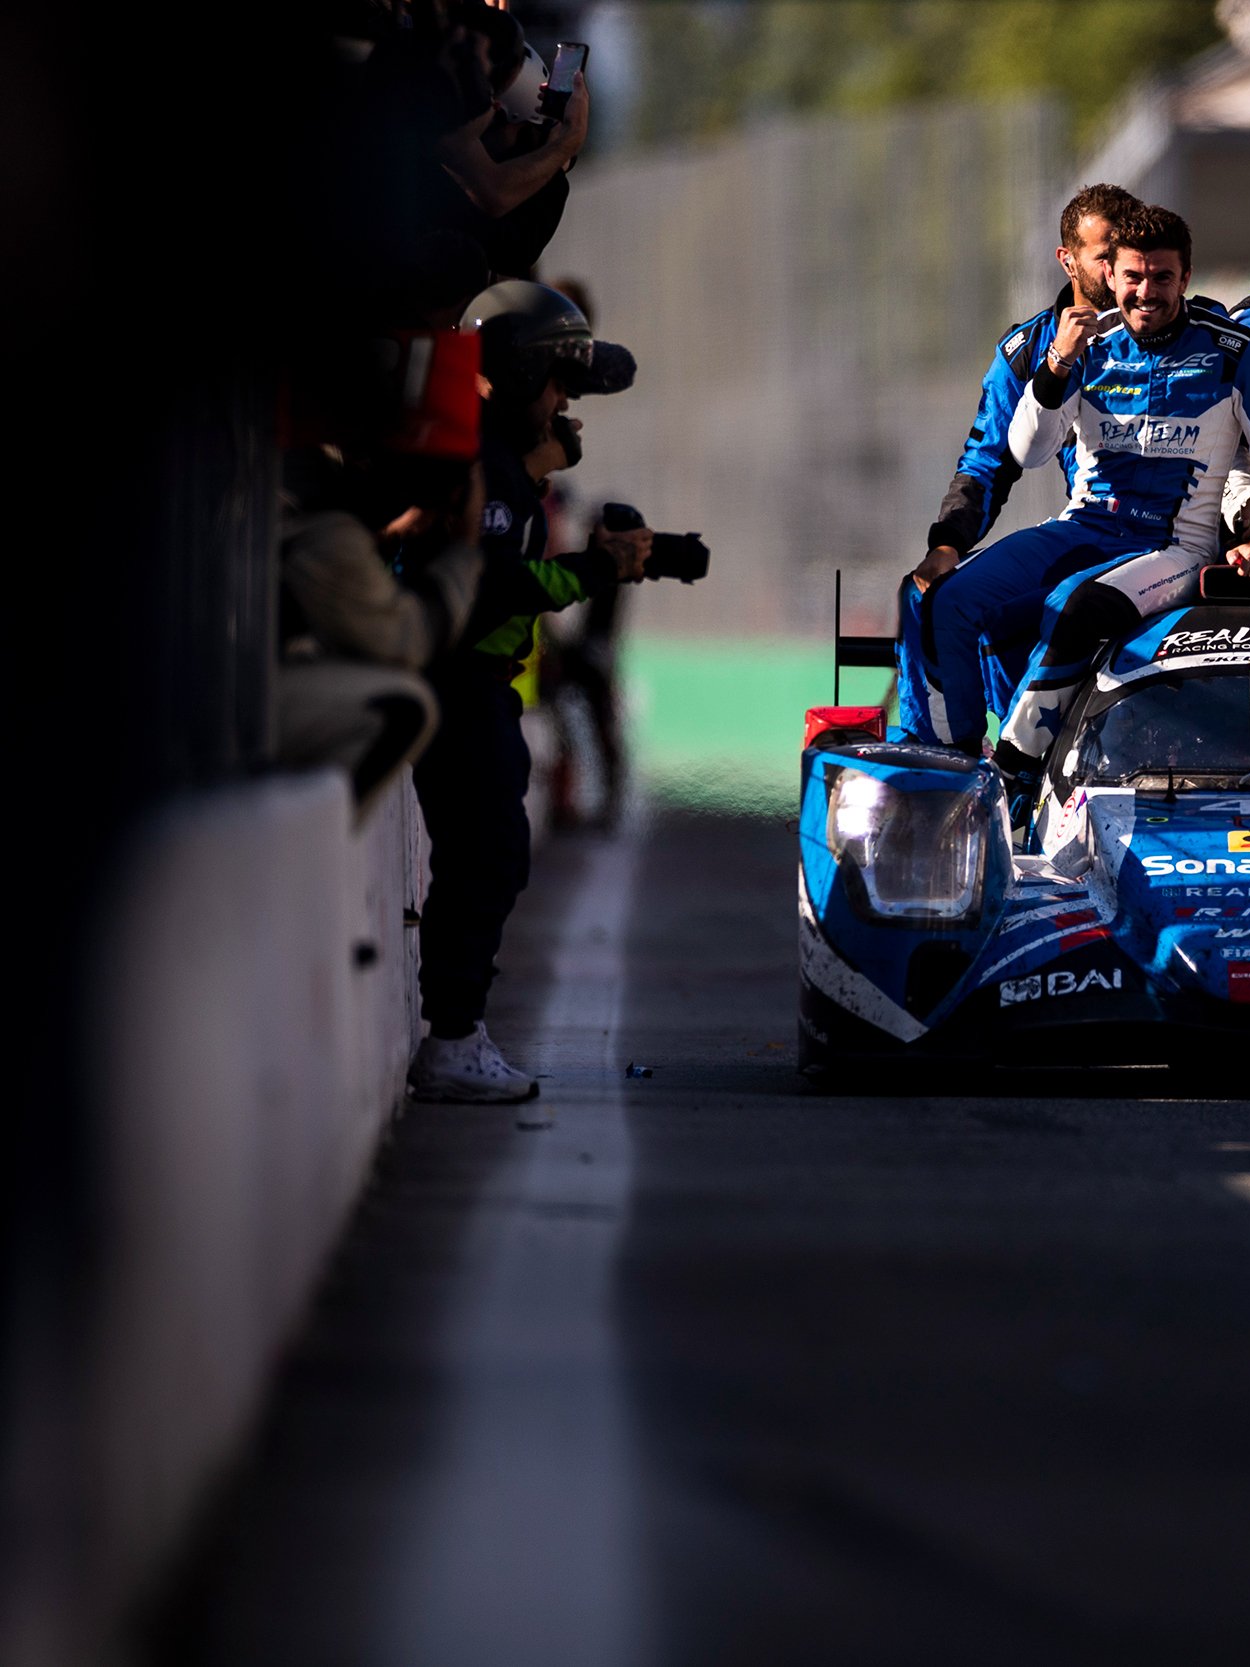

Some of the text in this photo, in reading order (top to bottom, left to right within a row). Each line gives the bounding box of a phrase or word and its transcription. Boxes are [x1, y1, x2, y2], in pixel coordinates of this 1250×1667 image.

[1219, 335, 1242, 349] OMP
[1084, 384, 1142, 396] GOODYEAR
[1105, 442, 1133, 450] RACING
[1150, 447, 1195, 455] HYDROGEN
[1130, 508, 1139, 517] N.
[1172, 643, 1228, 654] RACING
[1047, 968, 1122, 996] BAI
